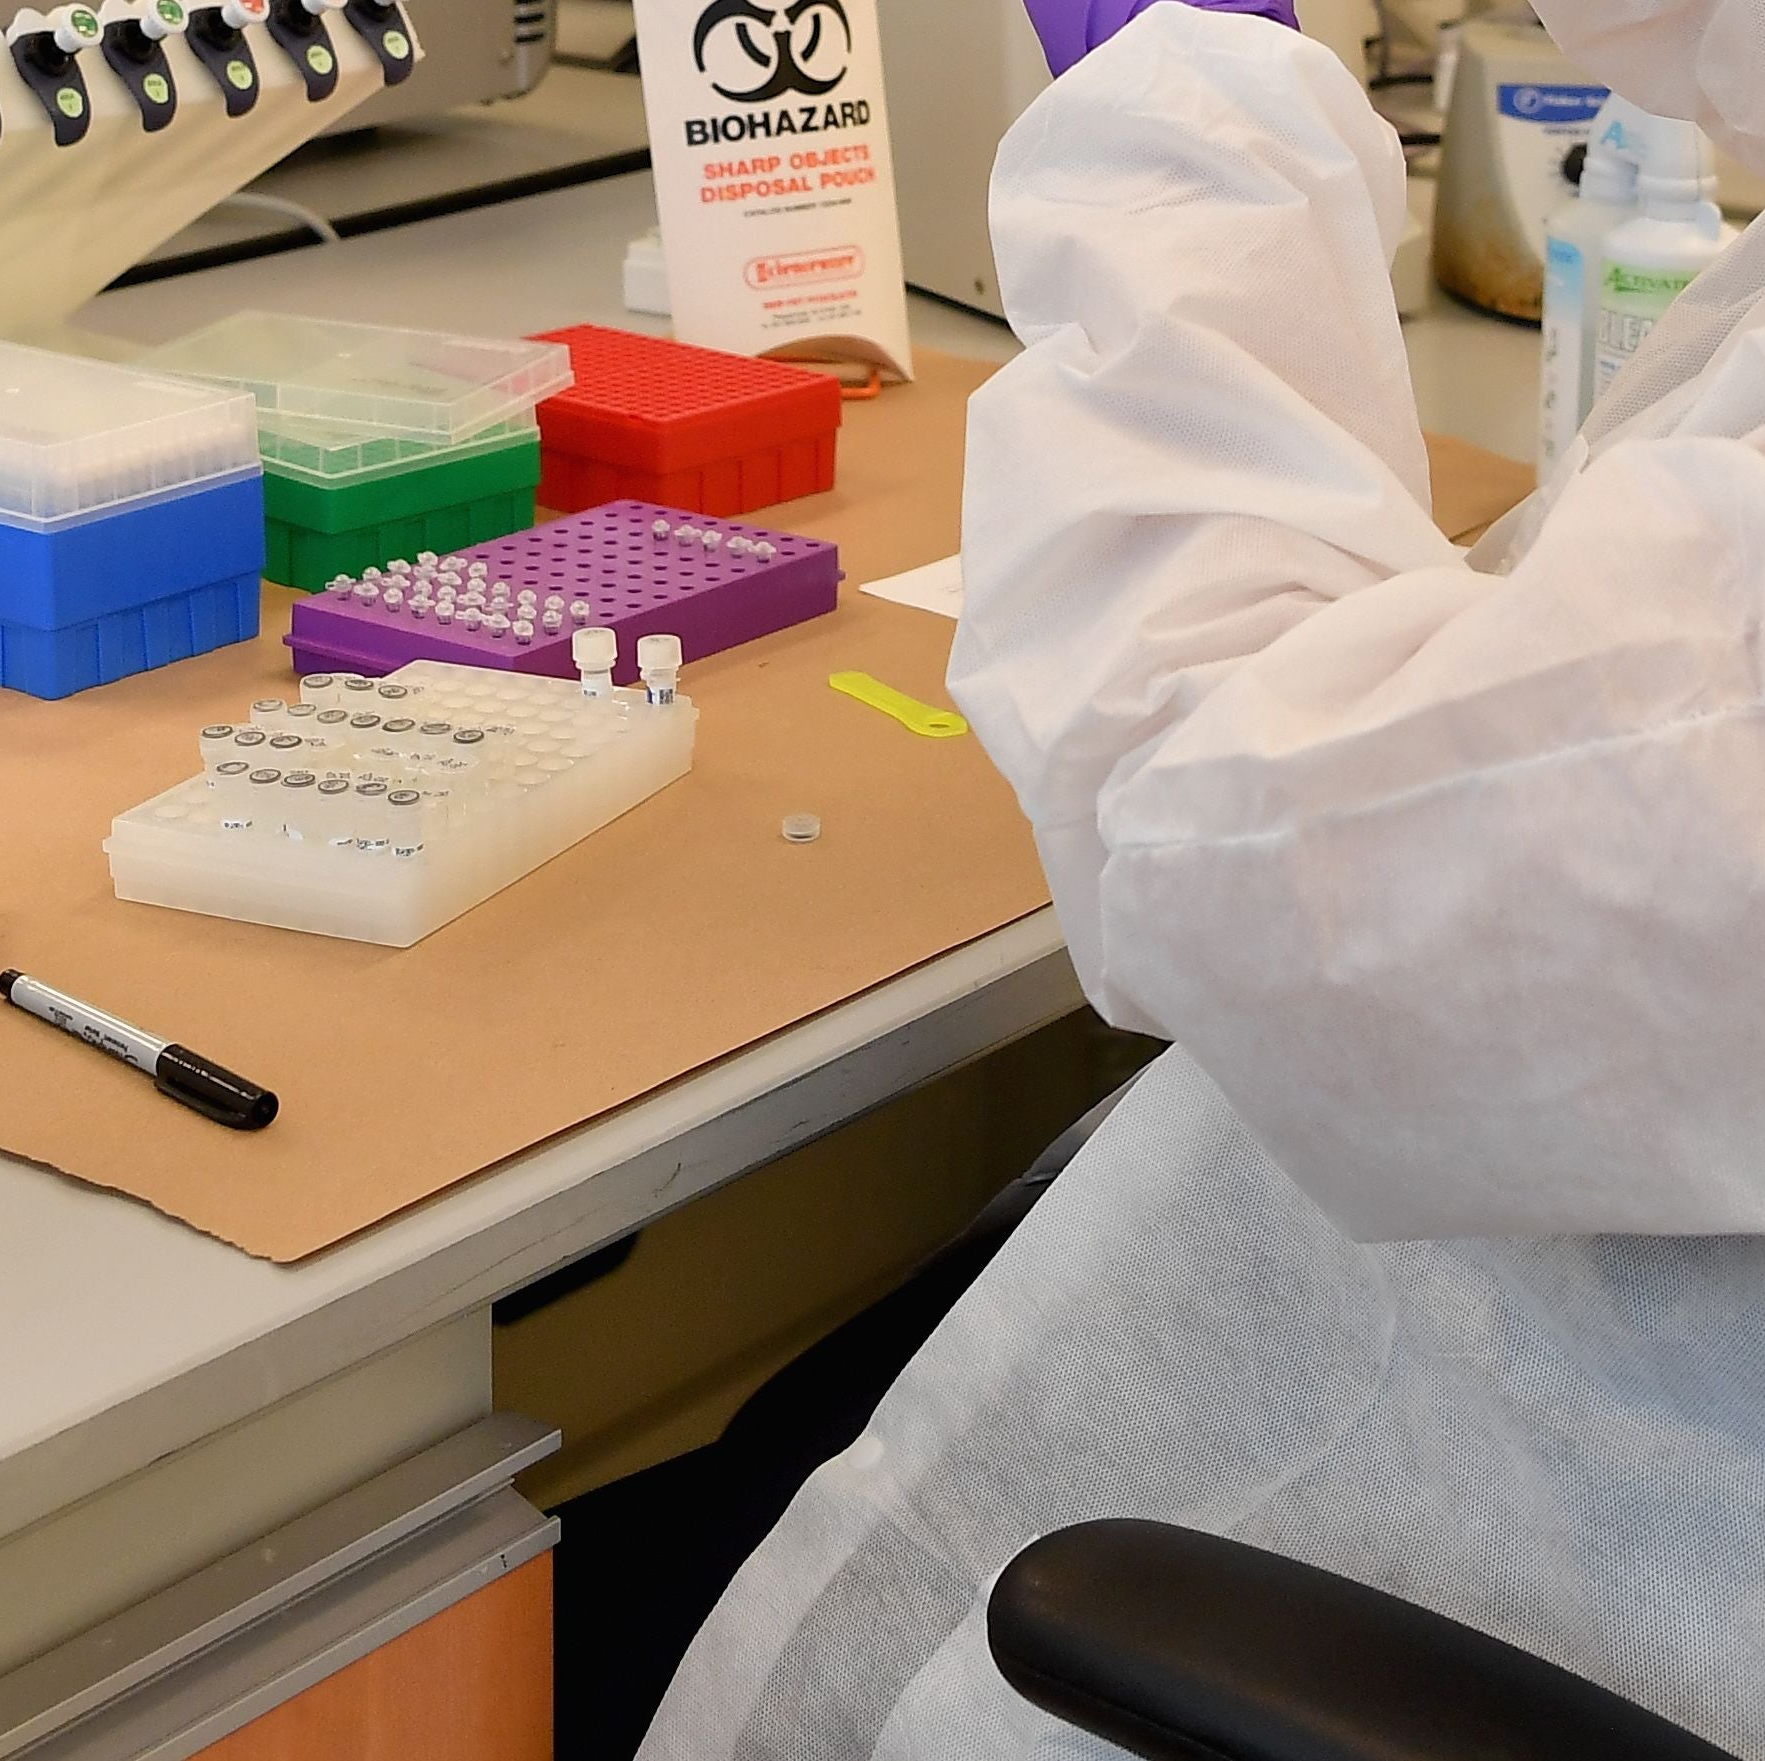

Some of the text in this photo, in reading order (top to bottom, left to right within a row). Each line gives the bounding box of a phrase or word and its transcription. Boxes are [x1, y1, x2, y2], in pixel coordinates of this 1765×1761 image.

[685, 100, 871, 146] BIOHAZARD
[704, 143, 870, 180] SHARP OBJECTS
[700, 177, 813, 203] DISPOSAL
[819, 166, 876, 189] POUCH
